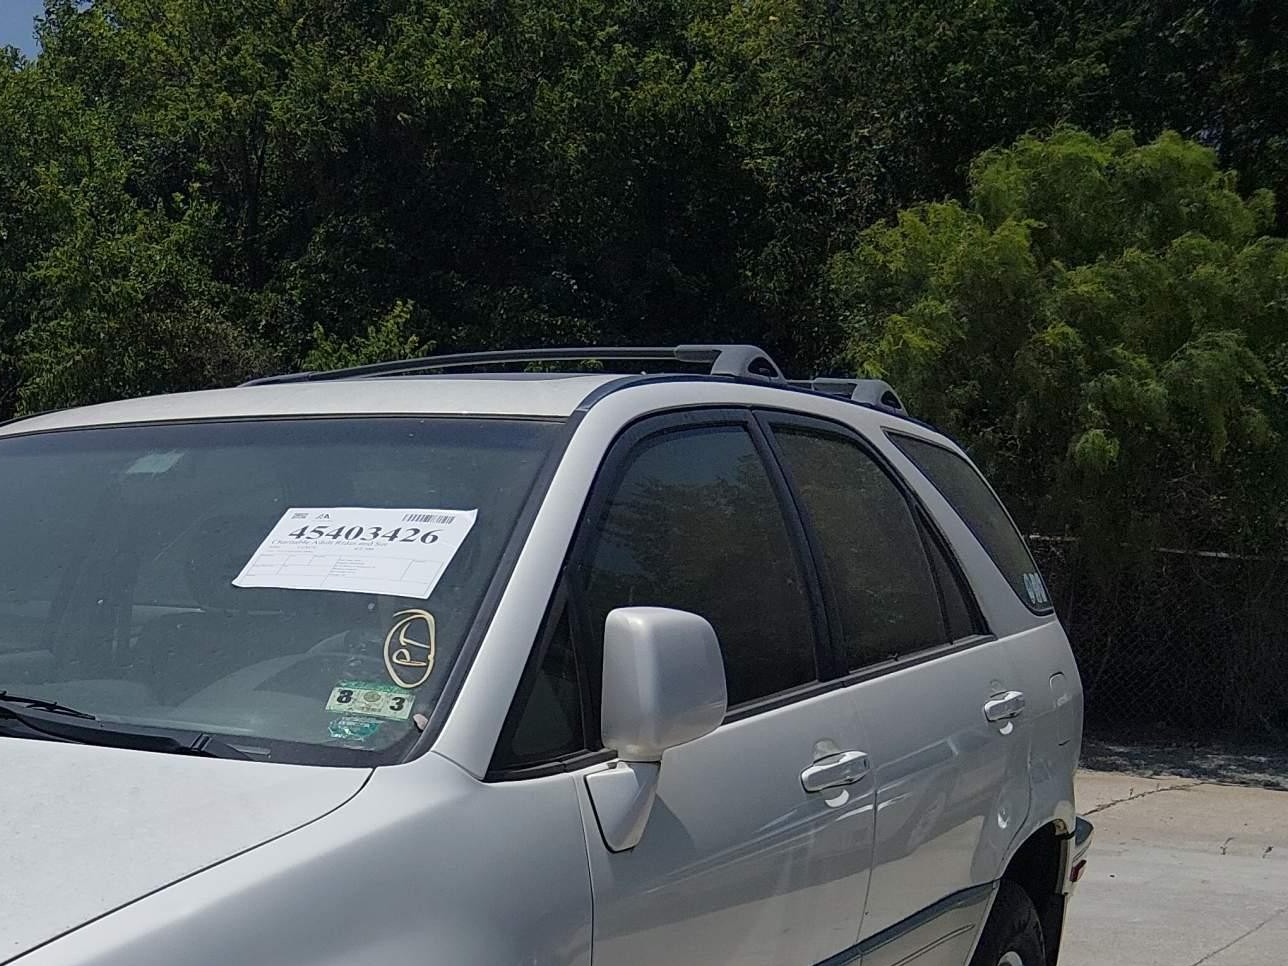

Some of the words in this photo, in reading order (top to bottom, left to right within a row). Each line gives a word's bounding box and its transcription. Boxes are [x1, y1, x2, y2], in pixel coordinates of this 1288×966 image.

[289, 524, 443, 545] 45403426
[337, 689, 353, 704] 8
[389, 697, 405, 711] 3
